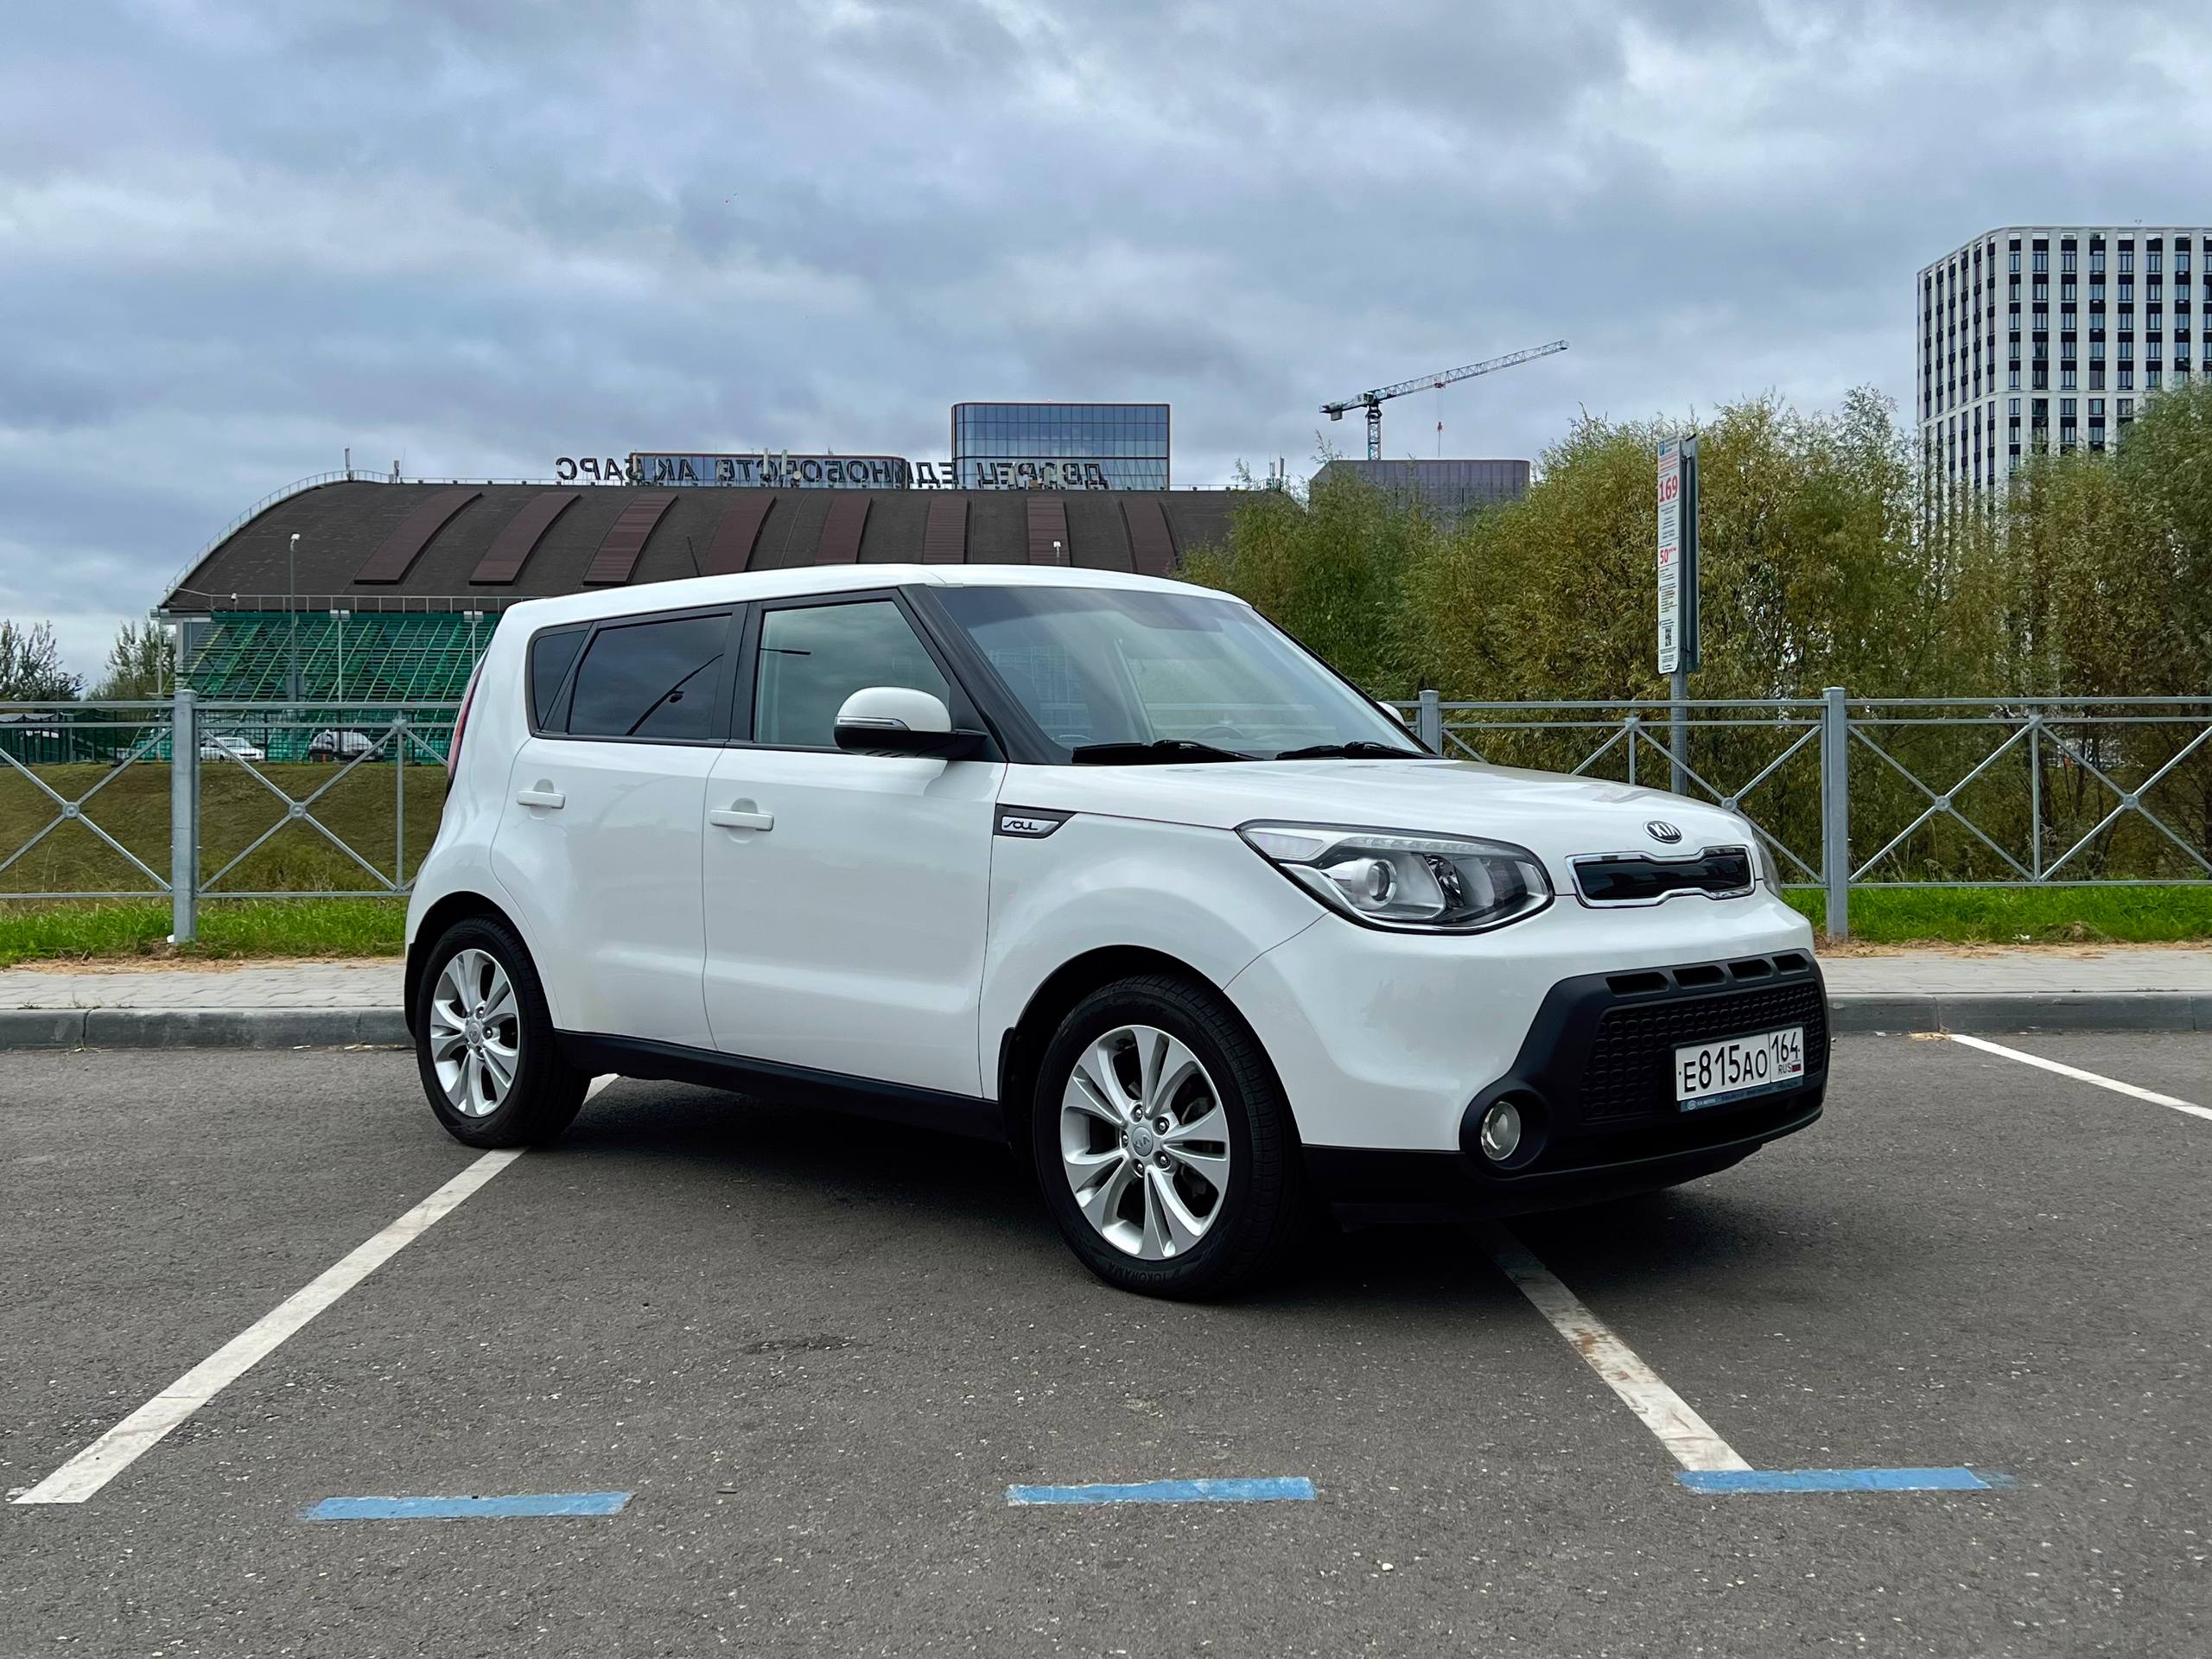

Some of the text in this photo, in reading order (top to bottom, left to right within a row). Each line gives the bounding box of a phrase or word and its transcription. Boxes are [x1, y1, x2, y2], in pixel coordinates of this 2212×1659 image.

[1659, 474, 1678, 502] 169
[1660, 549, 1669, 564] 50
[1003, 820, 1039, 830] SOUL
[1649, 823, 1681, 837] KIA
[1771, 1032, 1799, 1065] 164
[1777, 1064, 1792, 1075] RUS
[1133, 1136, 1150, 1149] KIA
